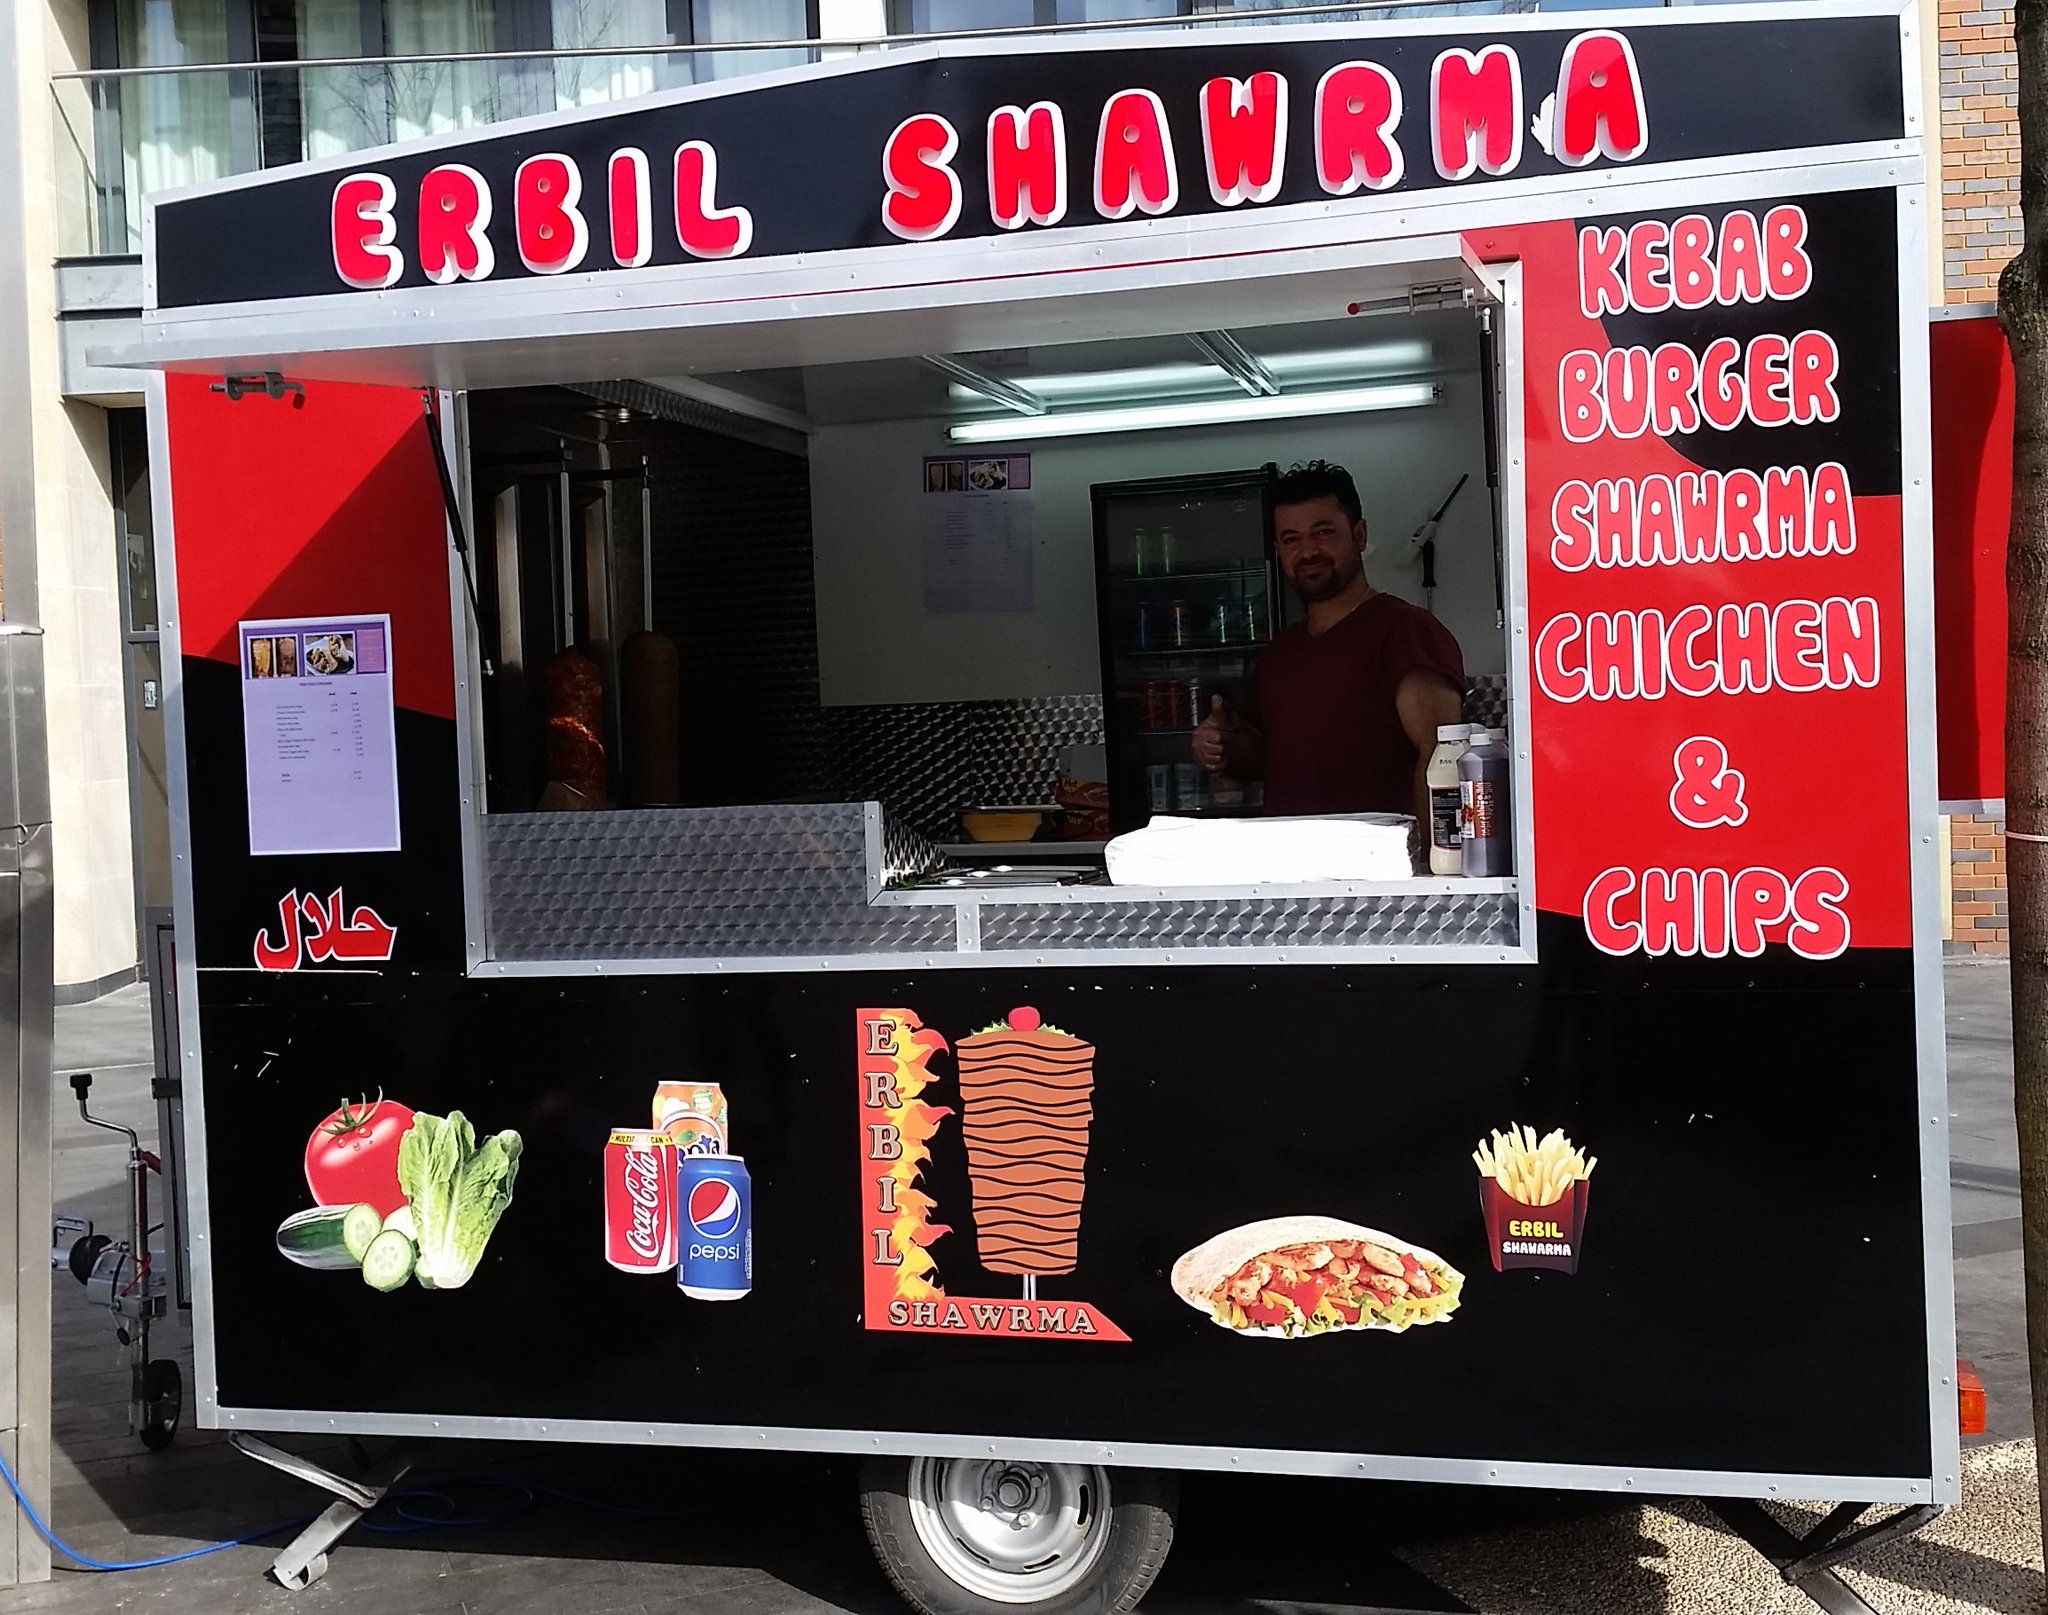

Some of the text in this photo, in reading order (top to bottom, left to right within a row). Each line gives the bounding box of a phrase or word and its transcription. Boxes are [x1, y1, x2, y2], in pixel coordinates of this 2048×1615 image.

[331, 28, 1650, 289] ERBIL SHAWRMA
[1578, 204, 1812, 319] KEBAB
[1559, 329, 1840, 443] BURGER
[1551, 461, 1857, 572] SHAWRMA
[1535, 596, 1881, 703] CHICHEN
[1669, 736, 1749, 828] &
[254, 886, 398, 972] حلال
[1583, 866, 1850, 960] CHIPS
[865, 1020, 904, 1266] ERBIL
[689, 1243, 740, 1262] pepsi
[1502, 1241, 1572, 1256] SHAWARMA
[1509, 1220, 1564, 1238] ERBIL
[888, 1300, 1099, 1335] SHAWRMA
